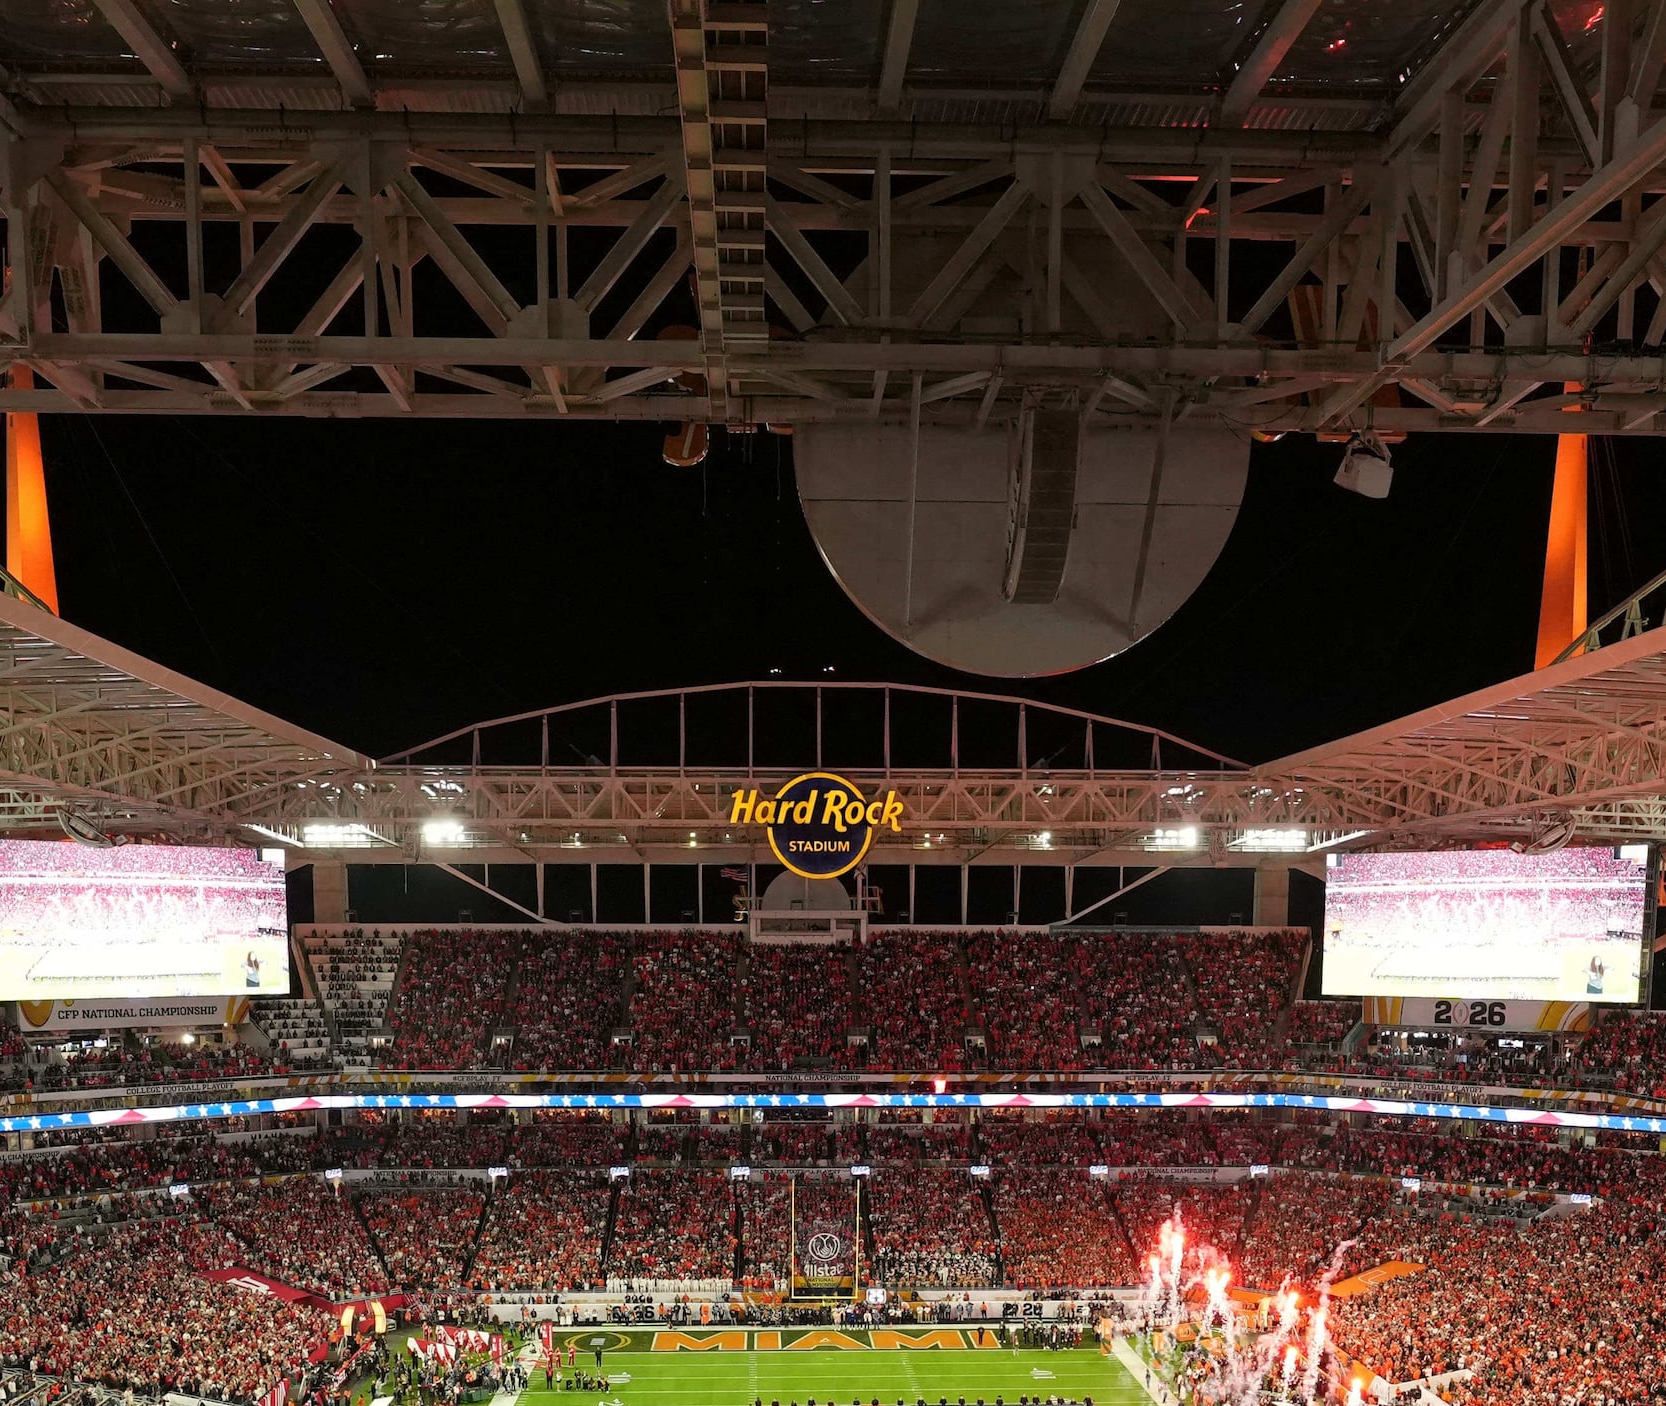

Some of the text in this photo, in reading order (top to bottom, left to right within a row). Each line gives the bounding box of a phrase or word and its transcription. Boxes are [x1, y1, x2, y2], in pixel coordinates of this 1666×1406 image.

[730, 789, 904, 832] Hard Rock
[789, 840, 850, 852] STADIUM
[58, 1006, 218, 1020] CFP NATIONAL CHAMPIONSHIP
[765, 1074, 861, 1082] NATIONAL CHAMPIONSHIP
[126, 1082, 235, 1095] COLLEGE FOOTBALL PLAYOFF
[1380, 1081, 1484, 1093] COLLEGE FOOTBALL PLAYOFF
[650, 1329, 1002, 1351] MIAMI
